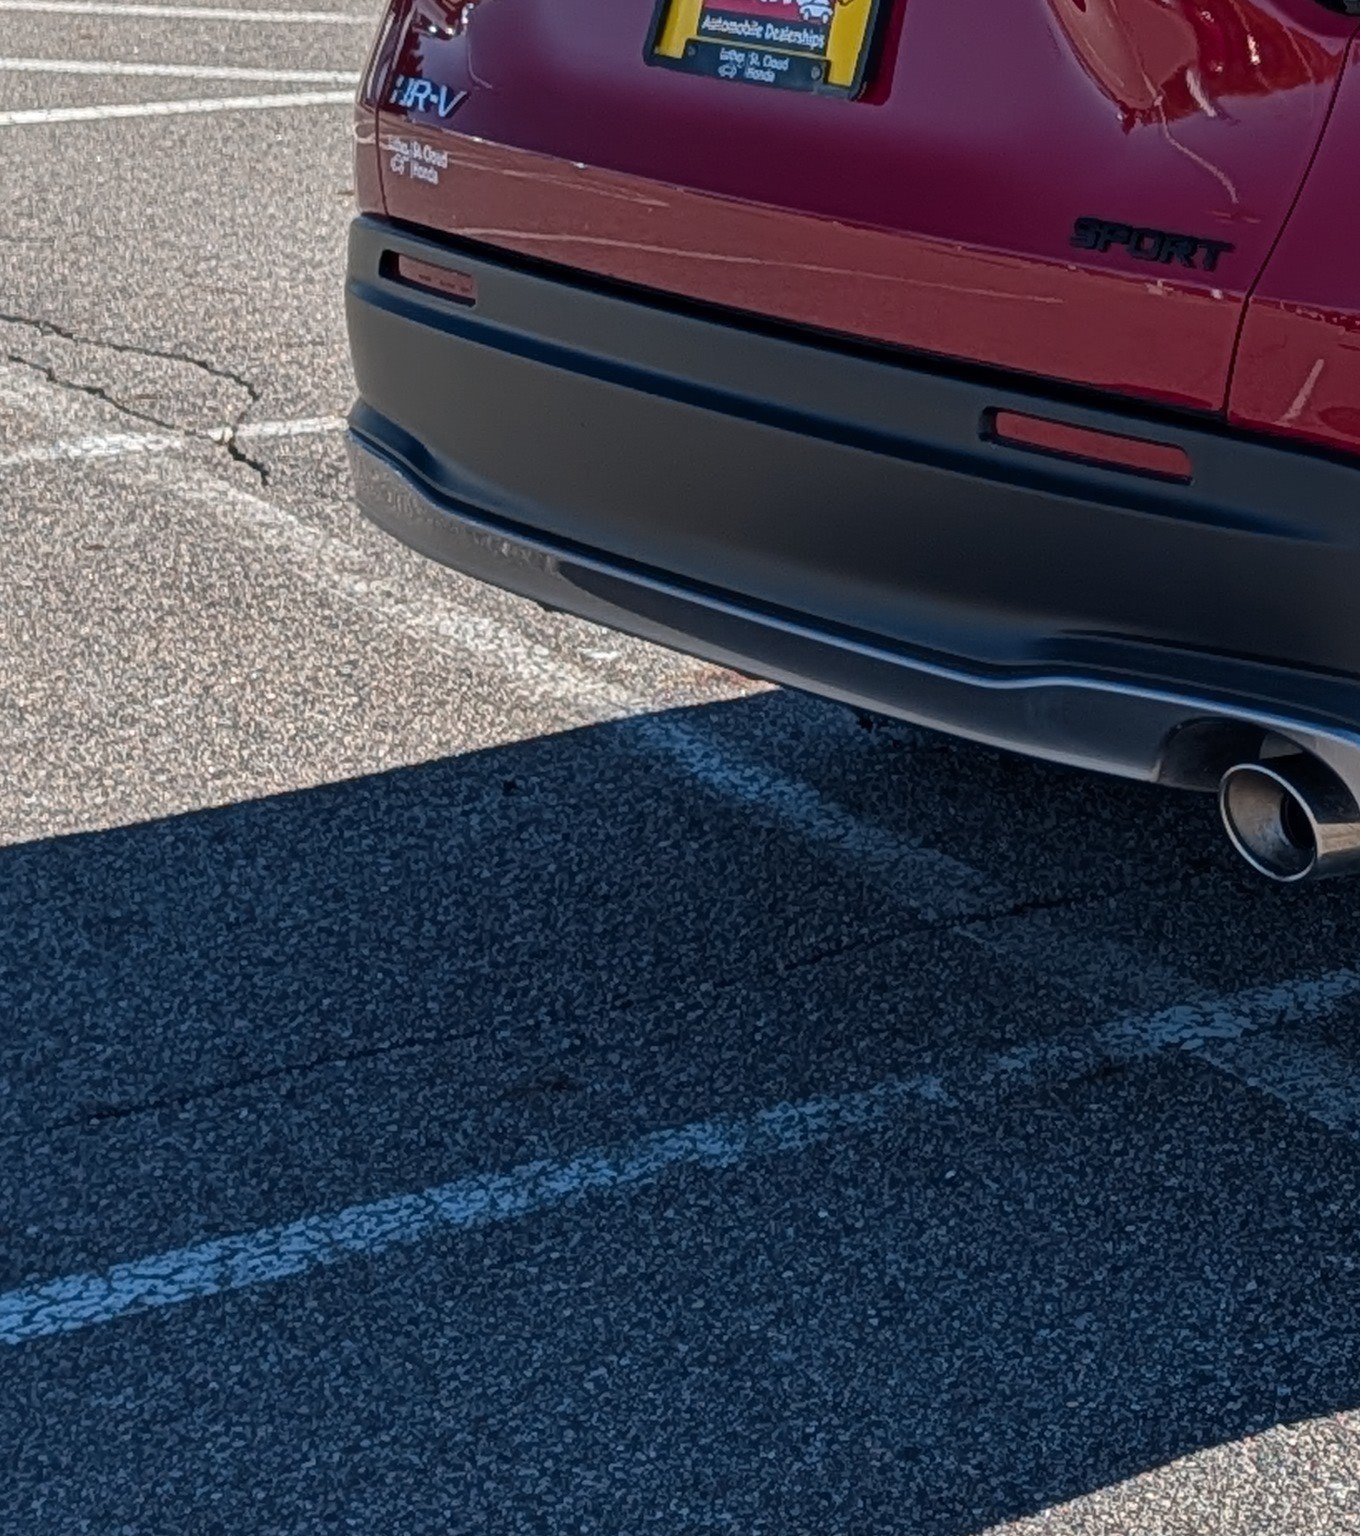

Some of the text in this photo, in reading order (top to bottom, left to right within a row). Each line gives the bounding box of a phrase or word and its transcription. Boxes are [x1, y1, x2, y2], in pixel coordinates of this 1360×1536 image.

[701, 15, 825, 49] Automobile Dealerships
[389, 74, 467, 117] HR-V
[1070, 217, 1235, 272] SPORT
